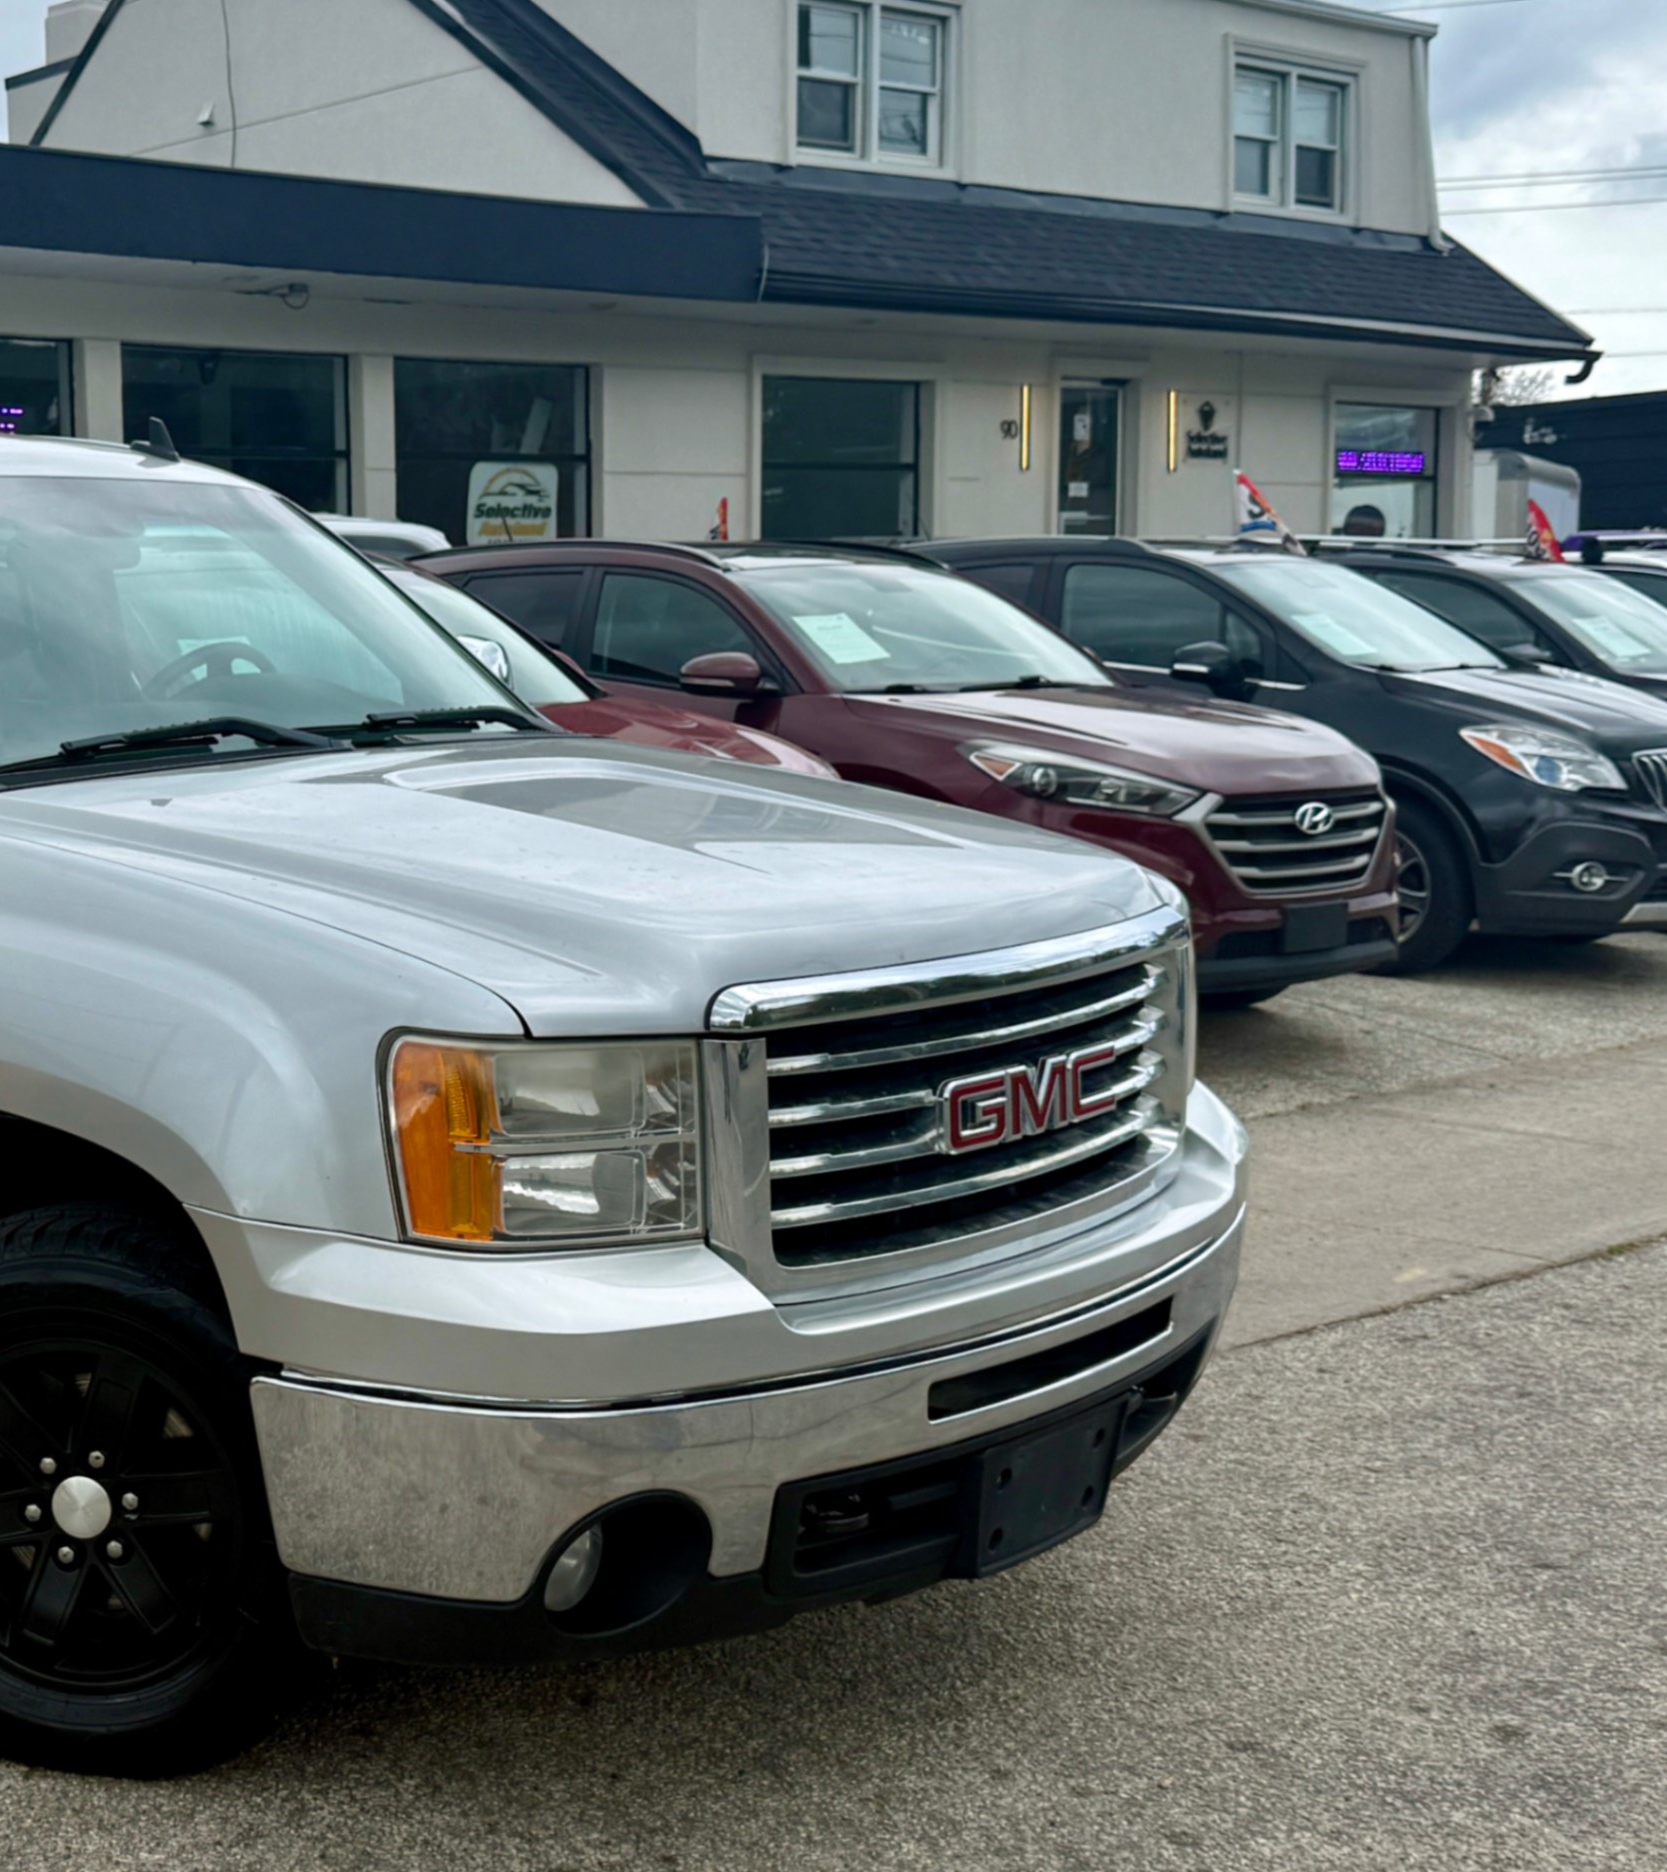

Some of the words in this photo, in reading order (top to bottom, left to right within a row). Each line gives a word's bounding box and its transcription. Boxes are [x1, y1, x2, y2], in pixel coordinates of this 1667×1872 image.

[1000, 419, 1019, 440] 90
[474, 502, 552, 519] Selective
[937, 1044, 1116, 1155] GMC
